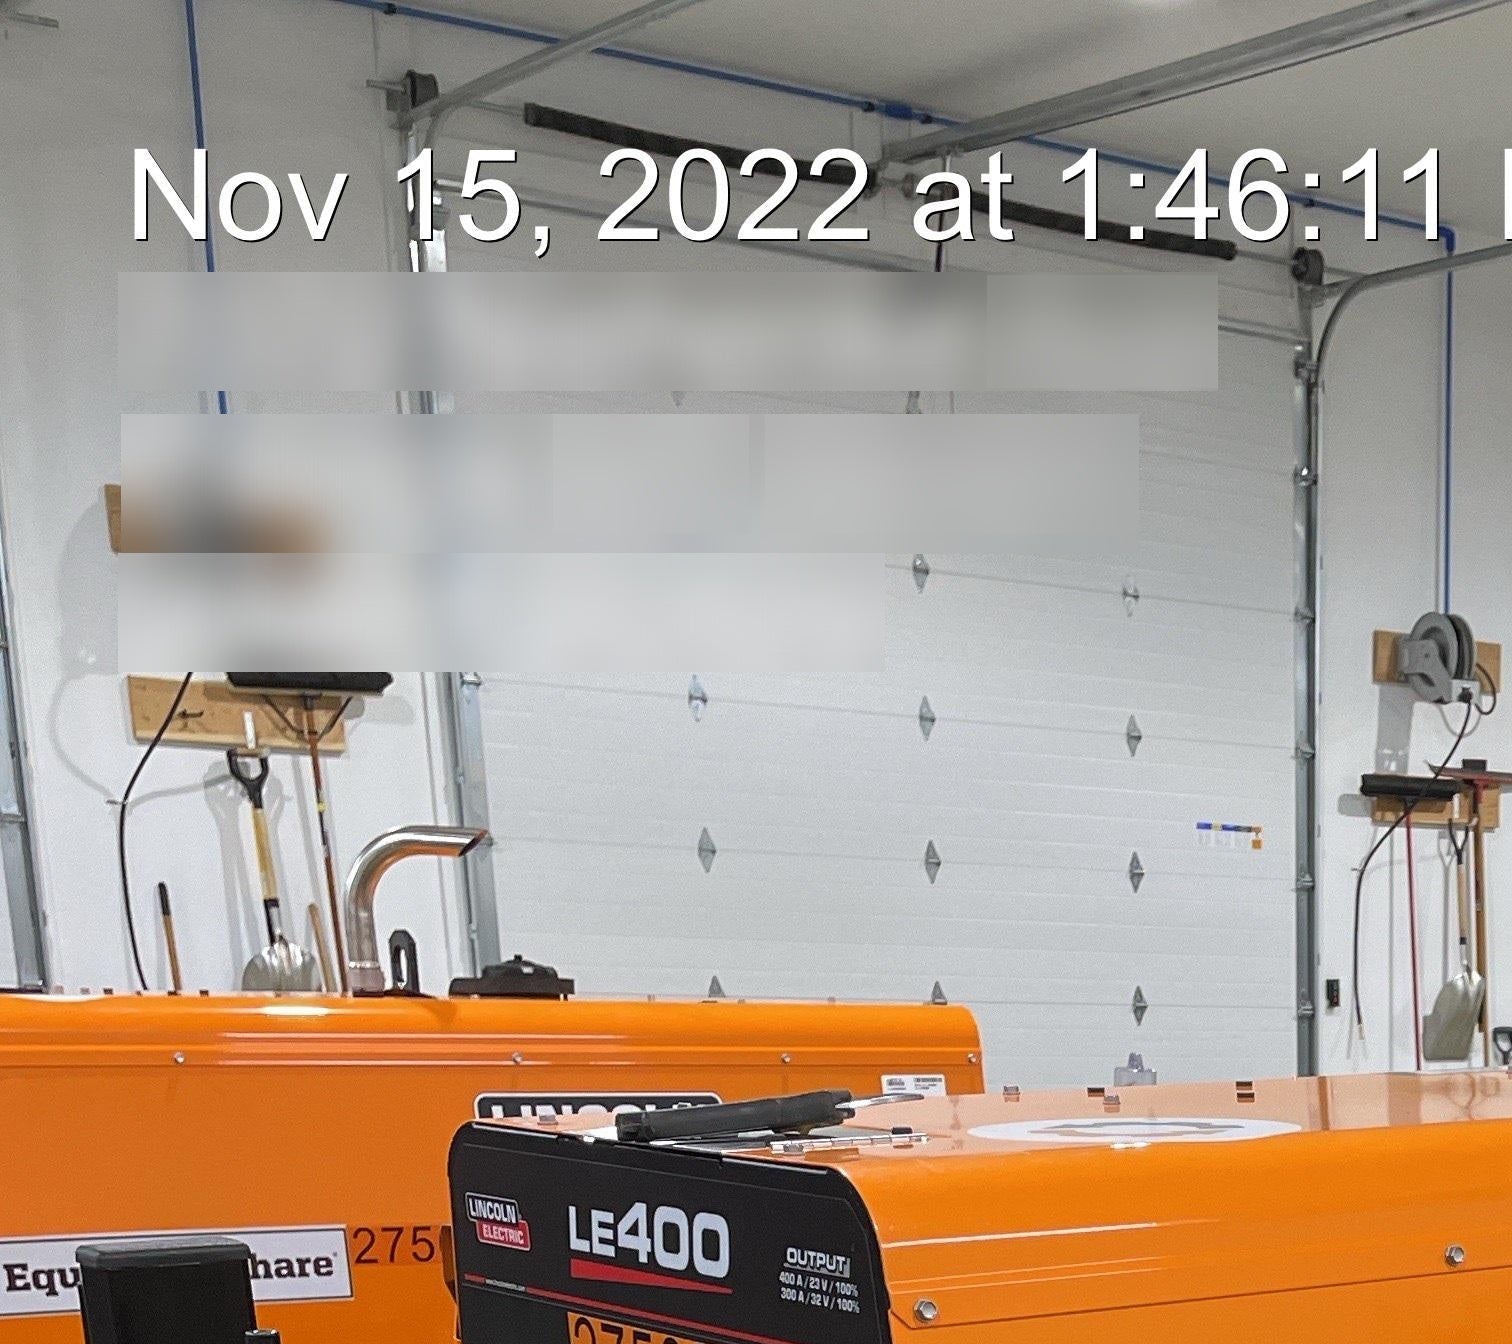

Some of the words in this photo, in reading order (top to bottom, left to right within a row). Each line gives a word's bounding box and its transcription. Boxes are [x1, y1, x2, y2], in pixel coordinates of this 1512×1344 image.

[468, 1197, 517, 1225] LINCOLN
[353, 1226, 436, 1265] 275
[481, 1223, 525, 1246] ELECTRIC
[568, 1201, 732, 1279] LE400
[786, 1247, 846, 1272] OUTPUT
[779, 1271, 796, 1285] 400
